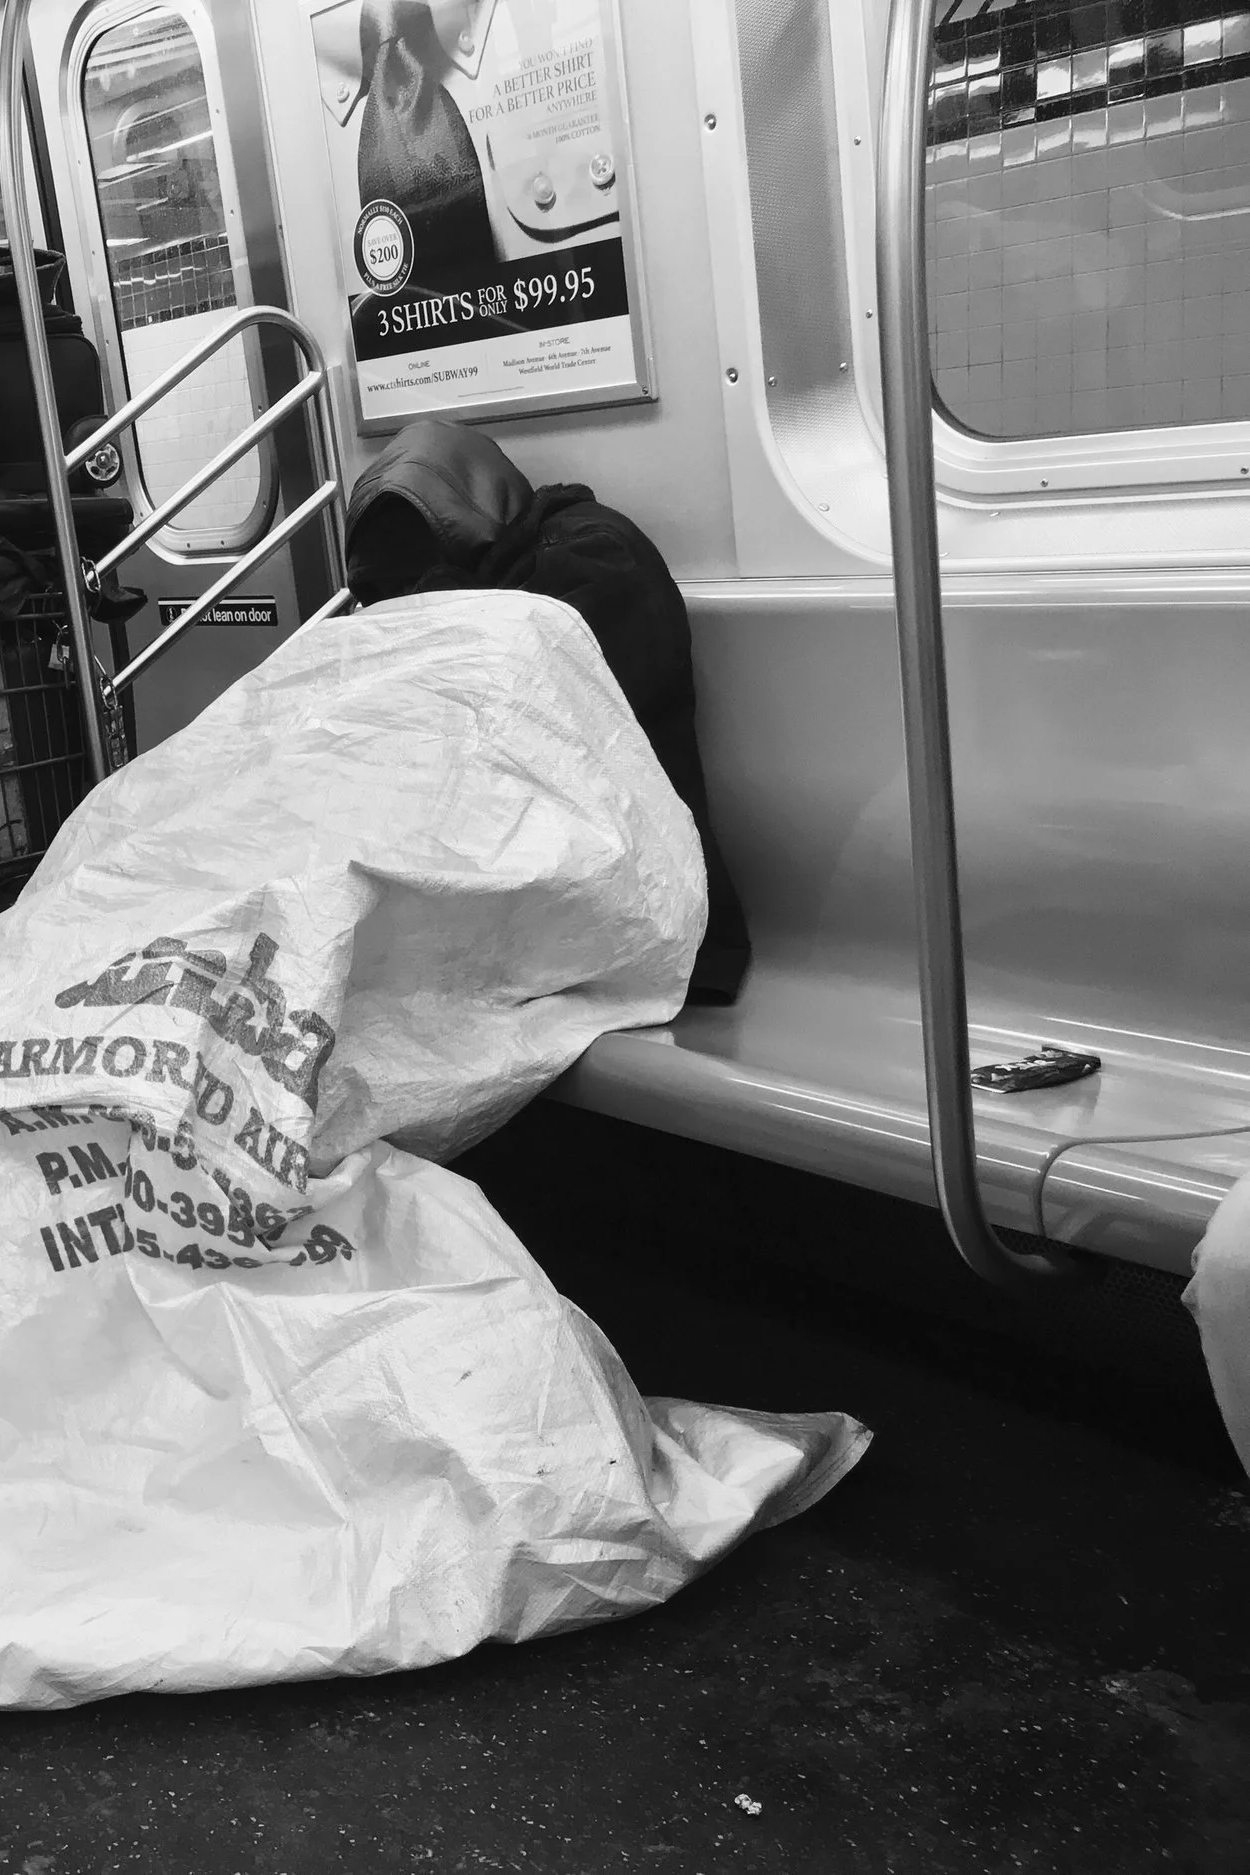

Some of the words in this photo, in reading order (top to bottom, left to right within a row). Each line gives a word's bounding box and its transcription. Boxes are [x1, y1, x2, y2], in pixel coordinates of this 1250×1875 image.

[569, 38, 593, 54] FIND
[493, 84, 502, 98] A
[504, 65, 552, 94] BETTER
[554, 51, 594, 78] SHIRT
[468, 104, 494, 124] FOR
[495, 101, 505, 116] A
[507, 84, 554, 113] BETTER
[557, 71, 596, 97] PRICE
[546, 90, 597, 115] ANYWHERE
[369, 244, 399, 265] $200
[377, 308, 392, 338] 3
[391, 290, 475, 336] SHIRTS
[477, 283, 507, 306] FOR
[513, 266, 596, 313] $99.95
[478, 299, 508, 318] ONLY
[407, 360, 431, 371] ONLINE
[502, 356, 525, 368] Madison
[525, 354, 545, 365] Avenue
[558, 350, 578, 361] Avenue
[591, 344, 611, 355] Avenue
[518, 364, 544, 375] Westfield
[544, 362, 560, 373] World
[561, 360, 576, 371] Trade
[577, 357, 596, 368] Center
[366, 366, 479, 393] www.ctshirts.com/SUBWAY99
[212, 608, 234, 622] lean
[234, 611, 248, 622] on
[248, 607, 272, 622] door
